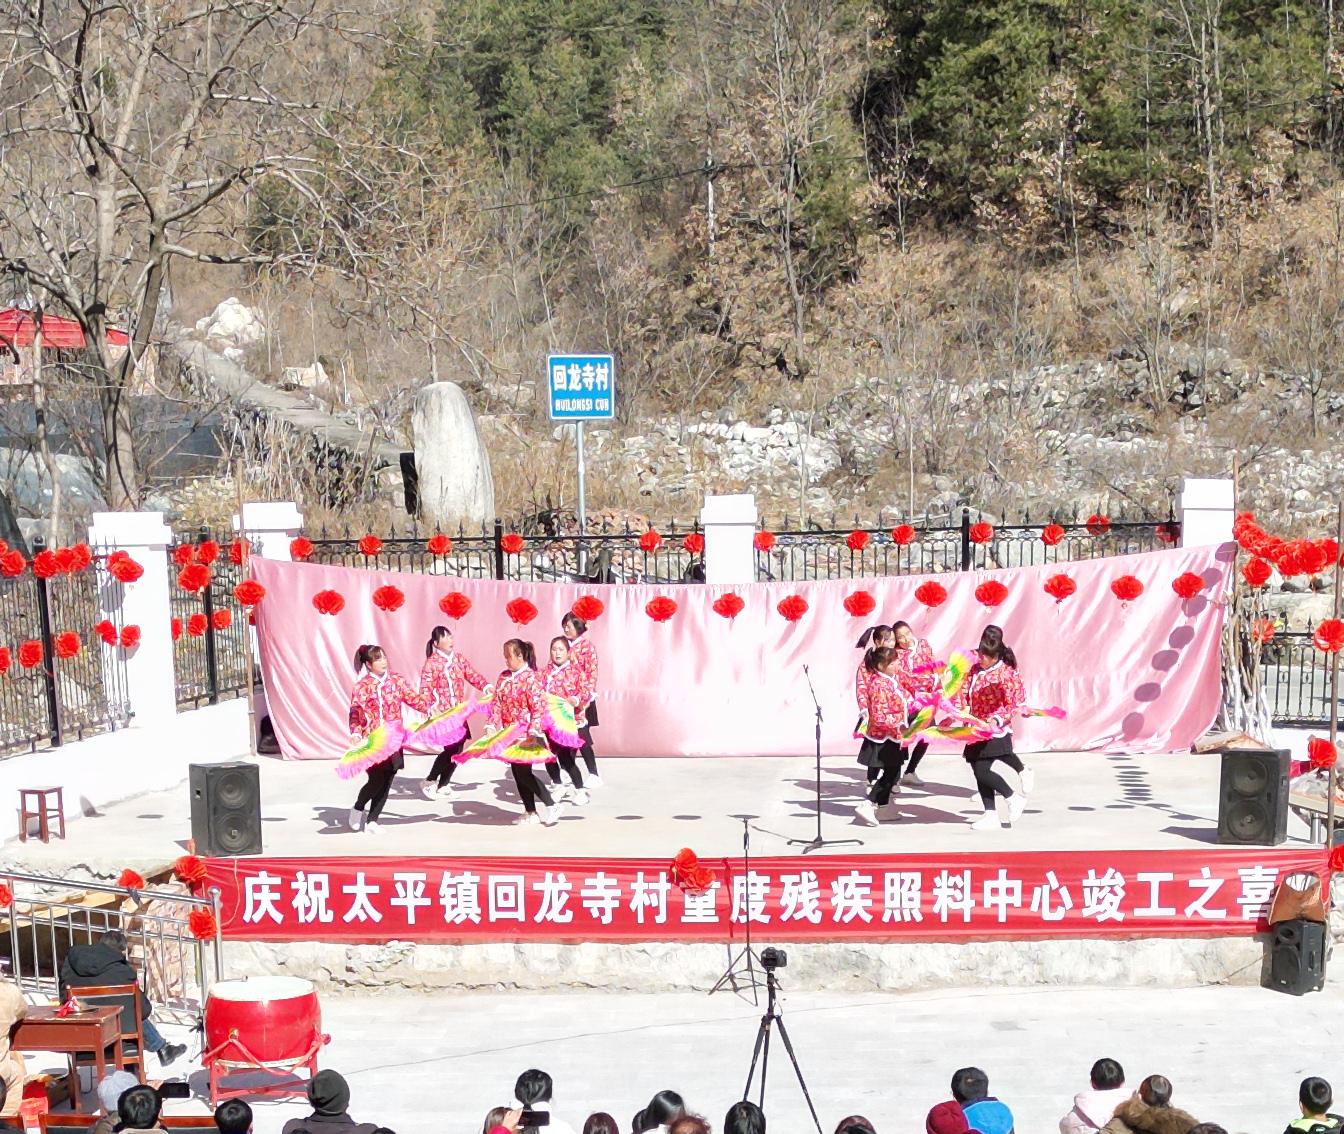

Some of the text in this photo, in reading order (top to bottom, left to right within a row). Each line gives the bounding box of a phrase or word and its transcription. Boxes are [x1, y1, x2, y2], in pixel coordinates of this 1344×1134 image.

[553, 362, 609, 391] 回龙寺村
[242, 866, 1281, 925] 庆祝太平镇回龙寺村重度残疾照料中心竣工之喜
